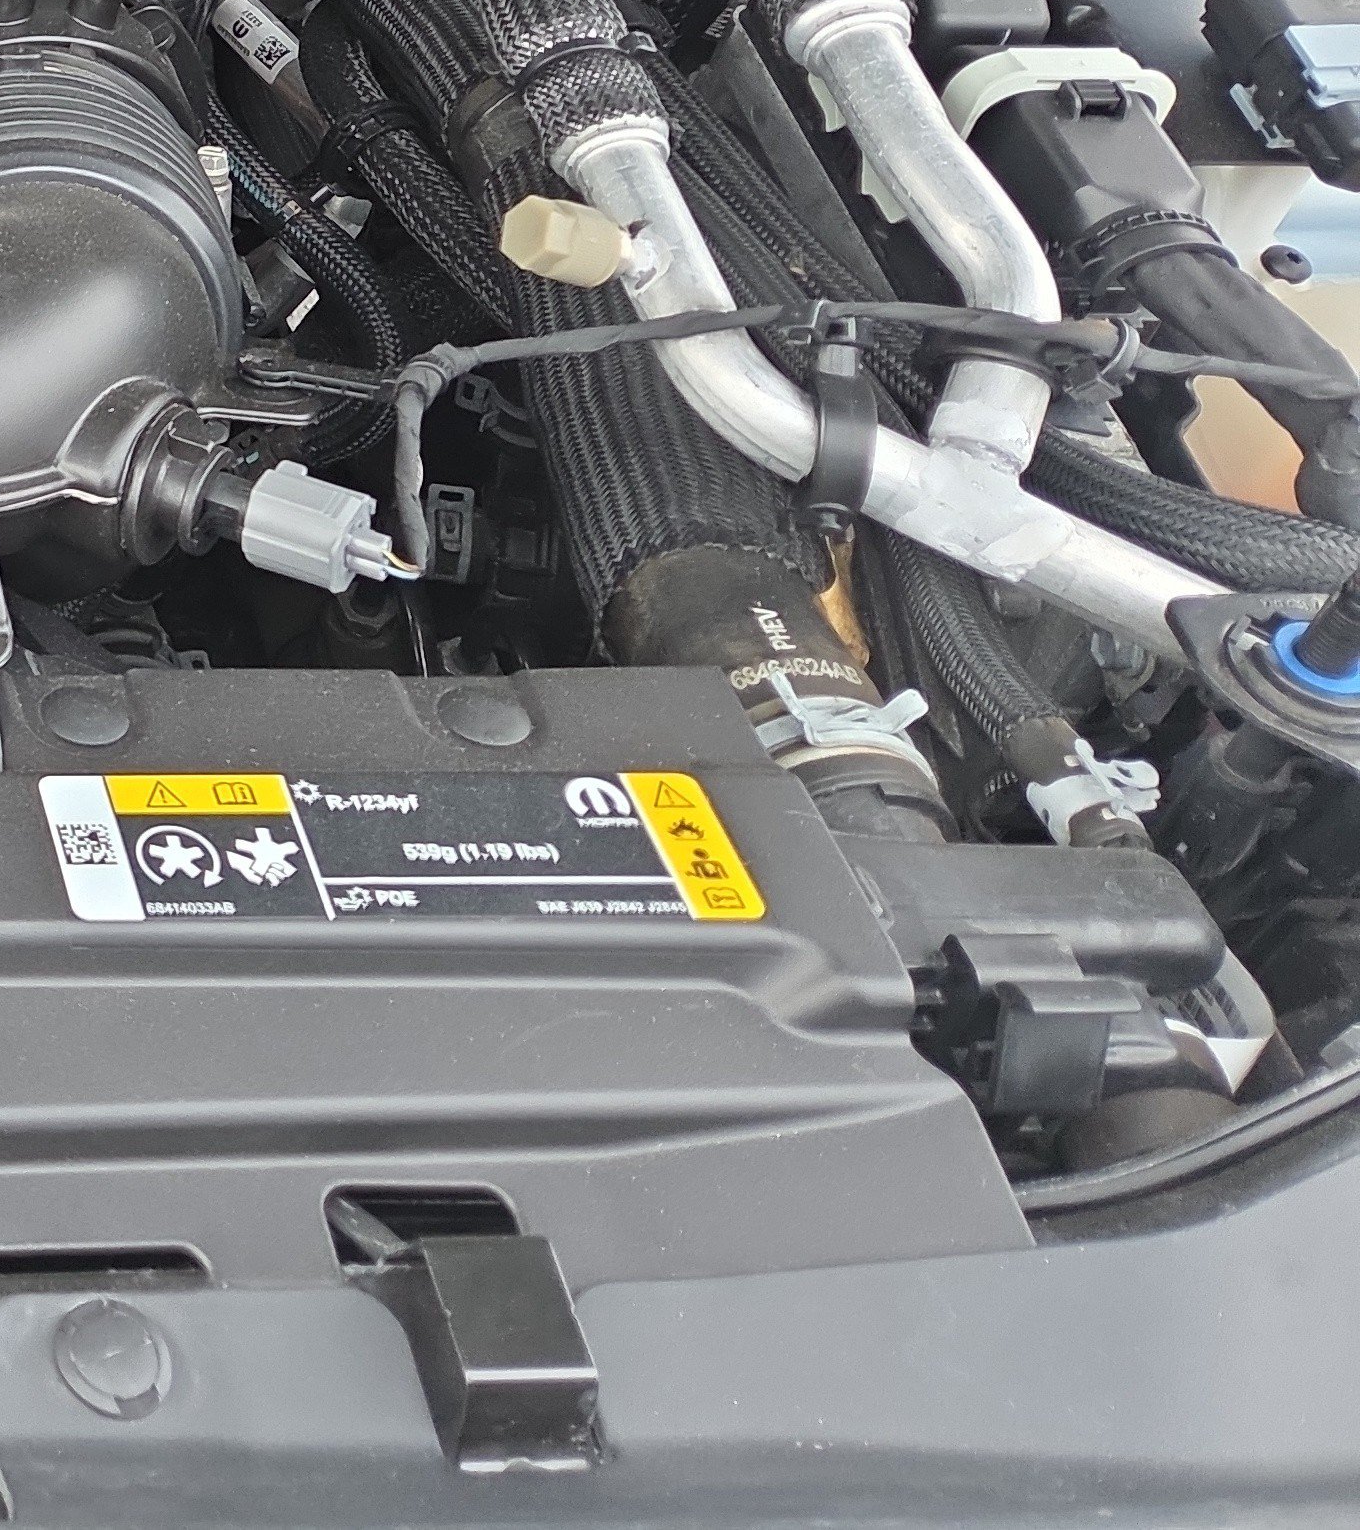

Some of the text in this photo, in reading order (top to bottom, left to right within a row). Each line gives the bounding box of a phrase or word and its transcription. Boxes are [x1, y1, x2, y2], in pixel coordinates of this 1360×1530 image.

[750, 606, 797, 652] PHEV
[324, 793, 420, 815] R-1234yf
[401, 842, 562, 865] 539g (1.19 lbs)
